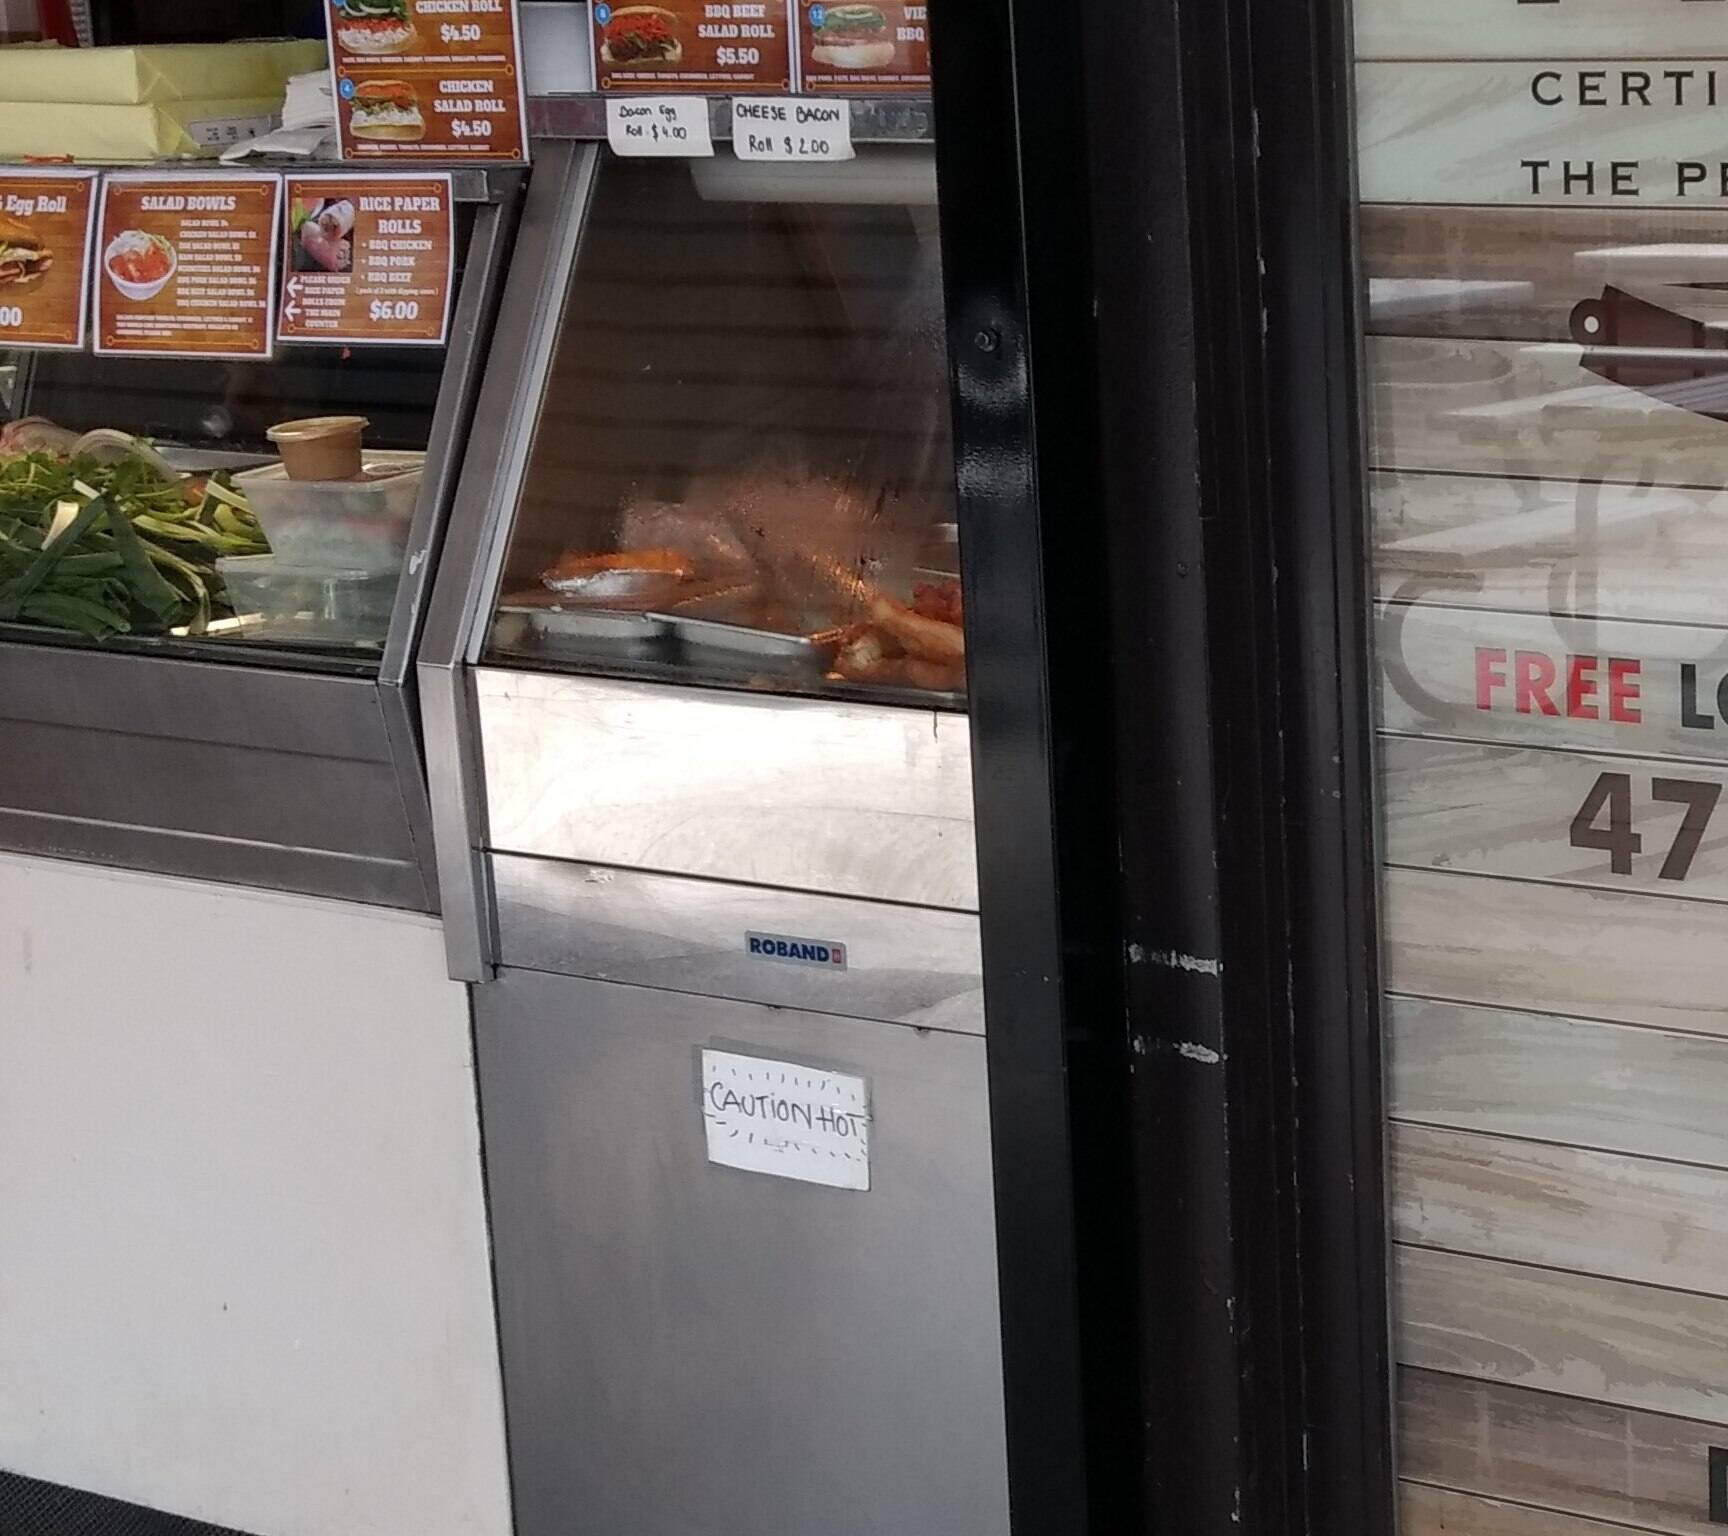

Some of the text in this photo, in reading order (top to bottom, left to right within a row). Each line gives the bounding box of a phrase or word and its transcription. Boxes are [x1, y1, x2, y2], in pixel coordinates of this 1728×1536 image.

[415, 0, 502, 14] CHICKEN ROLL
[440, 23, 480, 43] $4.50
[659, 104, 678, 120] Egg
[736, 104, 840, 124] CHEESE BACON
[749, 134, 773, 152] Roll
[1521, 160, 1640, 196] THE
[6, 195, 67, 216] Egg Roll
[140, 196, 236, 211] SALAD BOWLS
[360, 197, 440, 212] RICE PAPER
[378, 219, 422, 234] ROLLS
[369, 298, 418, 322] $6.00
[1474, 645, 1642, 725] FREE
[750, 936, 830, 963] ROBAND
[710, 1081, 863, 1139] CAUTION HOT
